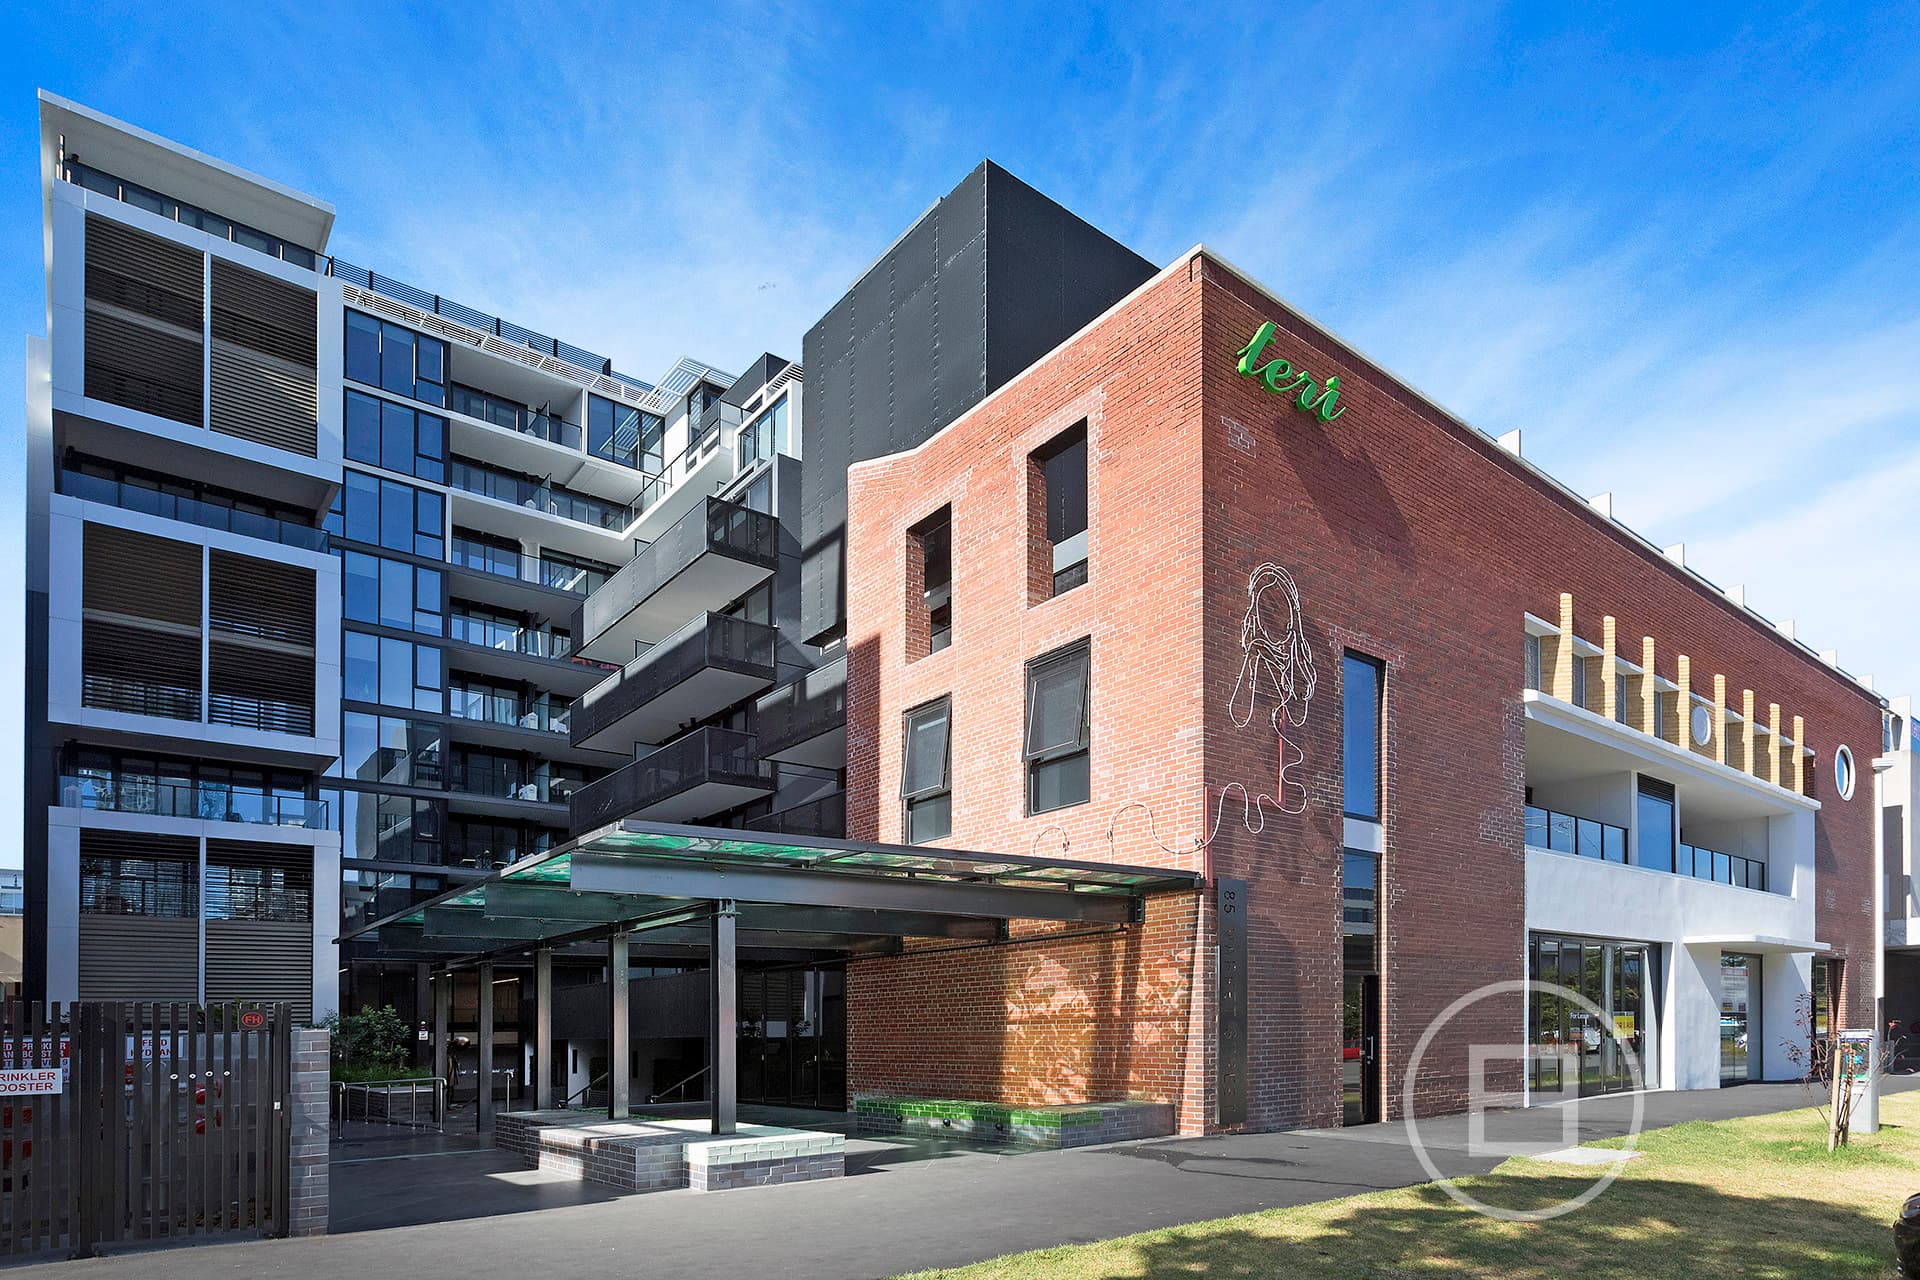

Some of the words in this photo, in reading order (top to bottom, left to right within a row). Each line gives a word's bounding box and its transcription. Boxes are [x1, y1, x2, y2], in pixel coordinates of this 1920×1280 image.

[1237, 321, 1346, 423] teri
[1223, 890, 1236, 914] 85
[245, 1014, 260, 1024] FH
[142, 1039, 168, 1047] FED
